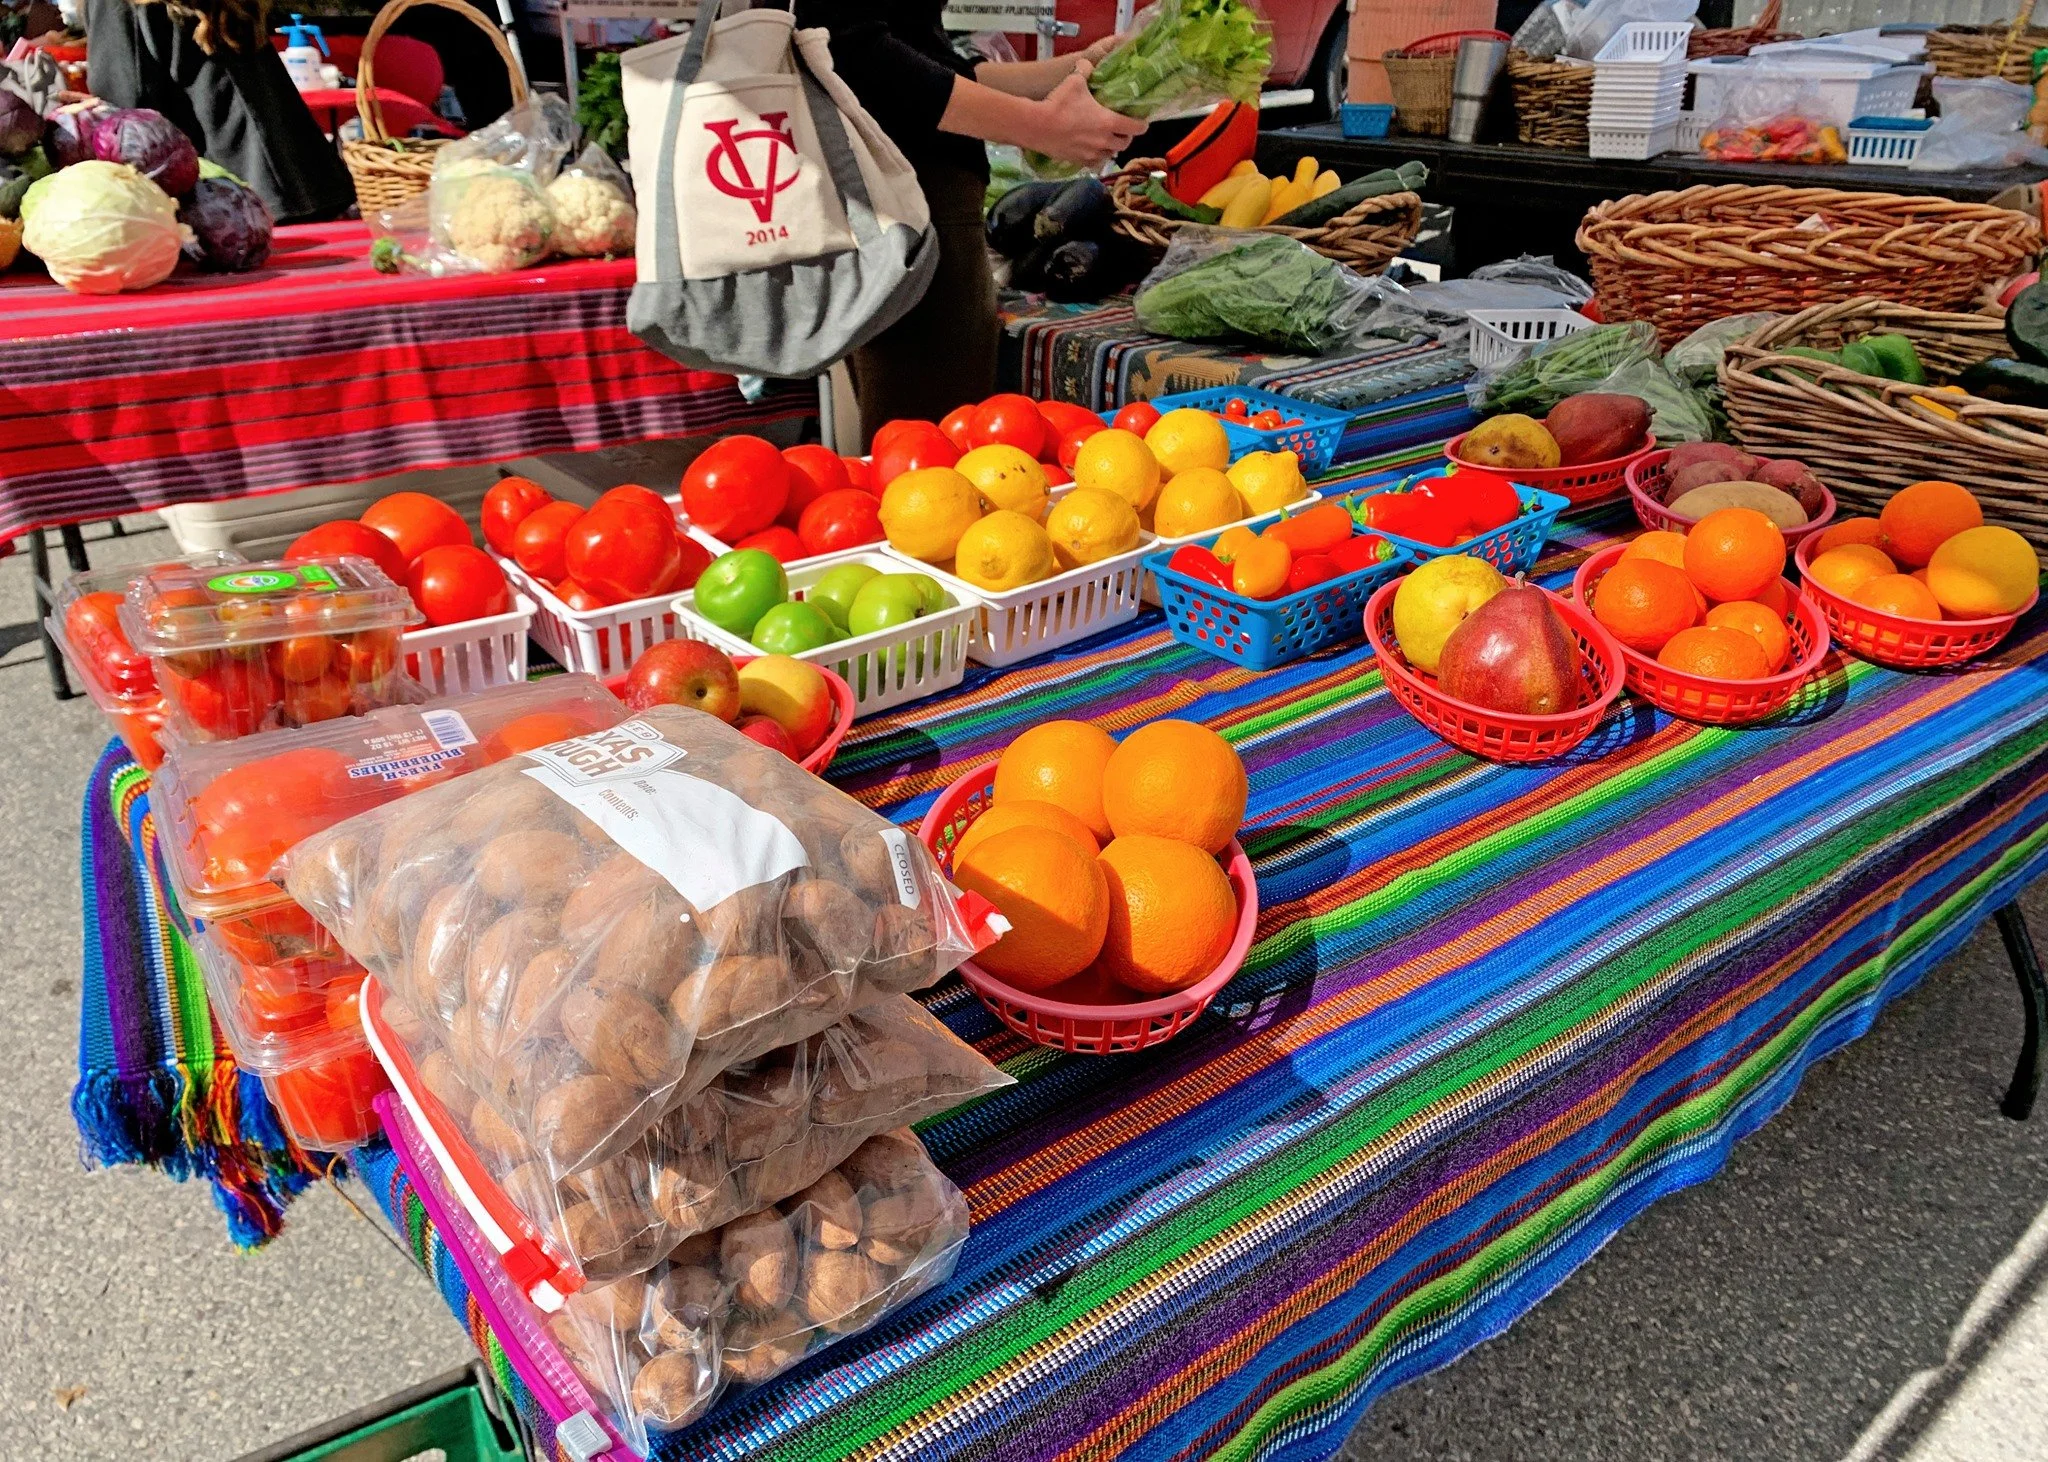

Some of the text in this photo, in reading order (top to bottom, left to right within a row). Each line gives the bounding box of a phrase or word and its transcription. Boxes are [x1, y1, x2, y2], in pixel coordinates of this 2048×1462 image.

[745, 225, 789, 246] 2014
[350, 748, 462, 777] BLUEBERRIES
[385, 762, 442, 780] FRESH
[541, 740, 625, 778] OUGH
[633, 779, 657, 796] Date:
[598, 788, 640, 822] Contents:
[894, 844, 915, 895] CLOSED
